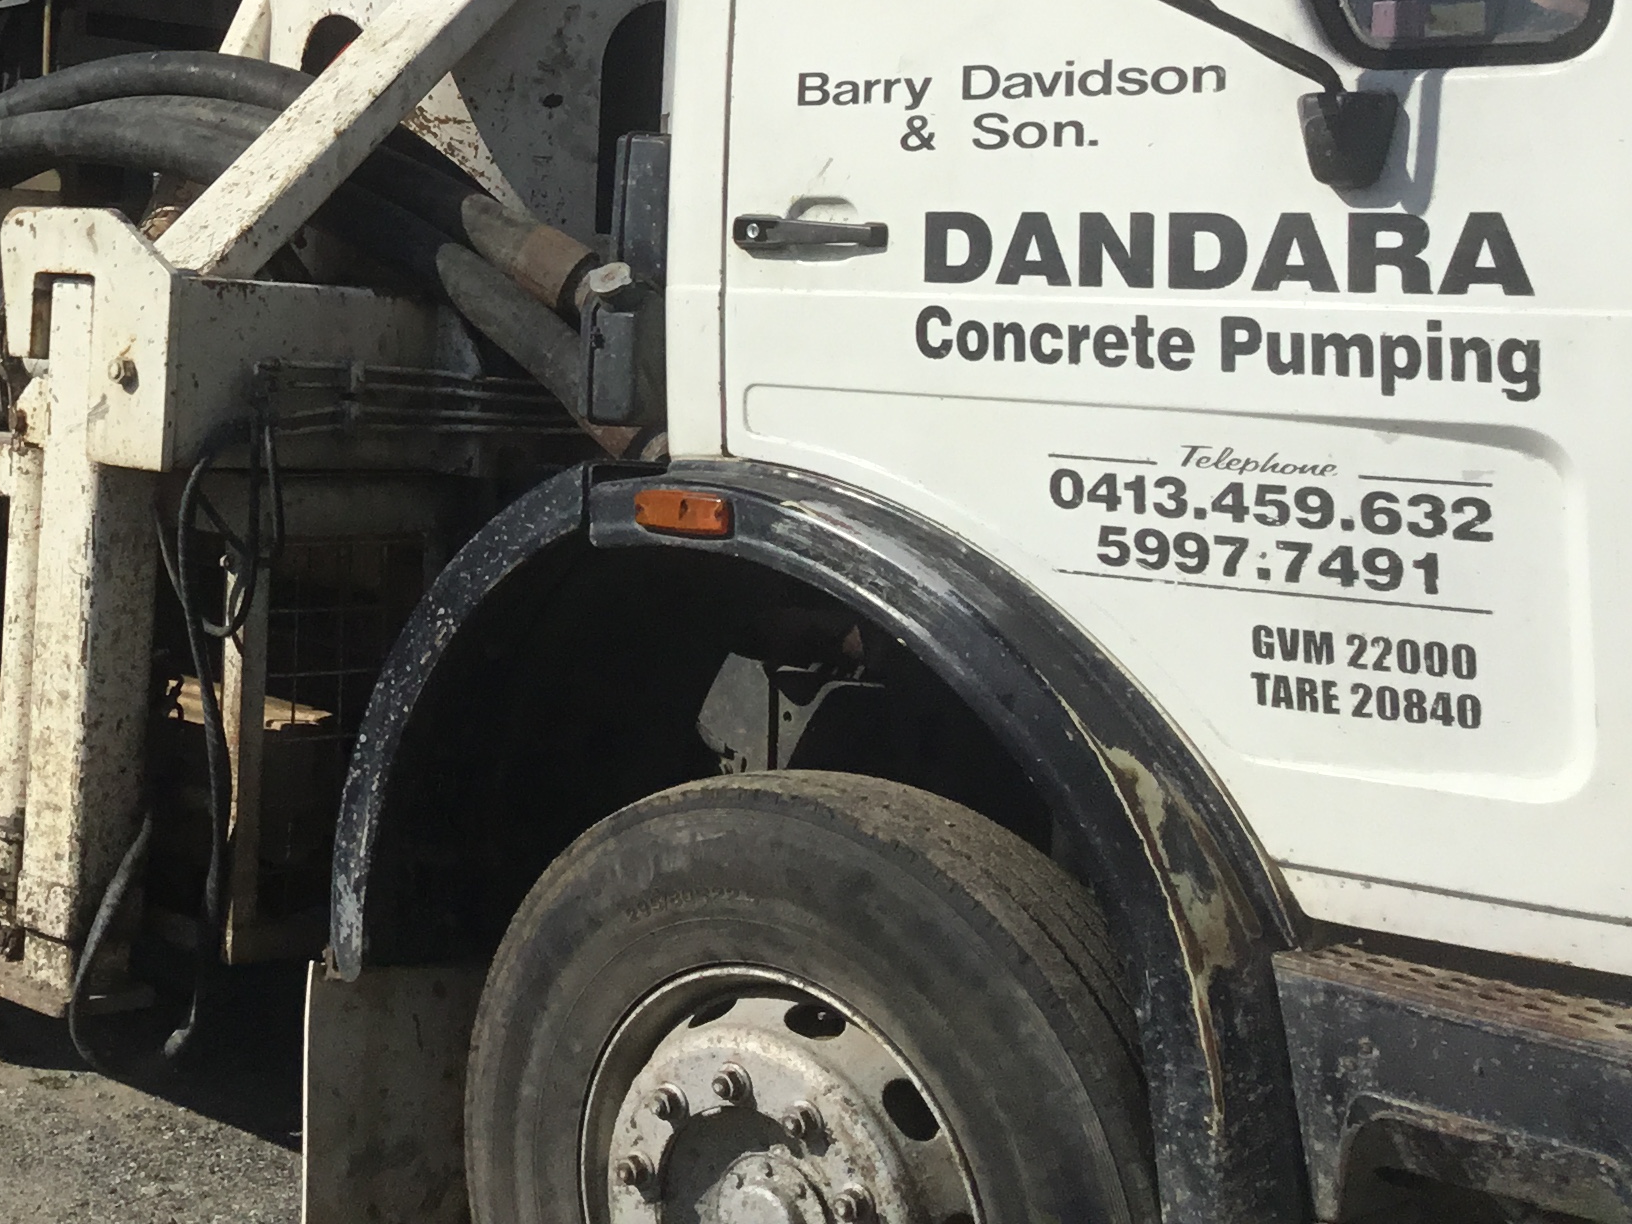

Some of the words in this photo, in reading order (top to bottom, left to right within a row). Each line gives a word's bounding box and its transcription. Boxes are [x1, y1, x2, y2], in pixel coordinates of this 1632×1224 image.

[797, 72, 932, 111] Barry
[962, 59, 1226, 101] Davidson
[900, 115, 936, 152] &
[972, 112, 1099, 150] Son.
[923, 211, 1535, 296] DANDARA
[915, 305, 1196, 372] Concrete
[1220, 315, 1541, 402] Pumping
[1179, 444, 1339, 477] Telephone
[1049, 468, 1494, 543] 0413.459.632
[1252, 624, 1335, 665] GVM
[1346, 633, 1477, 680] 22000
[1250, 671, 1341, 715] TARE
[1350, 682, 1482, 730] 20840
